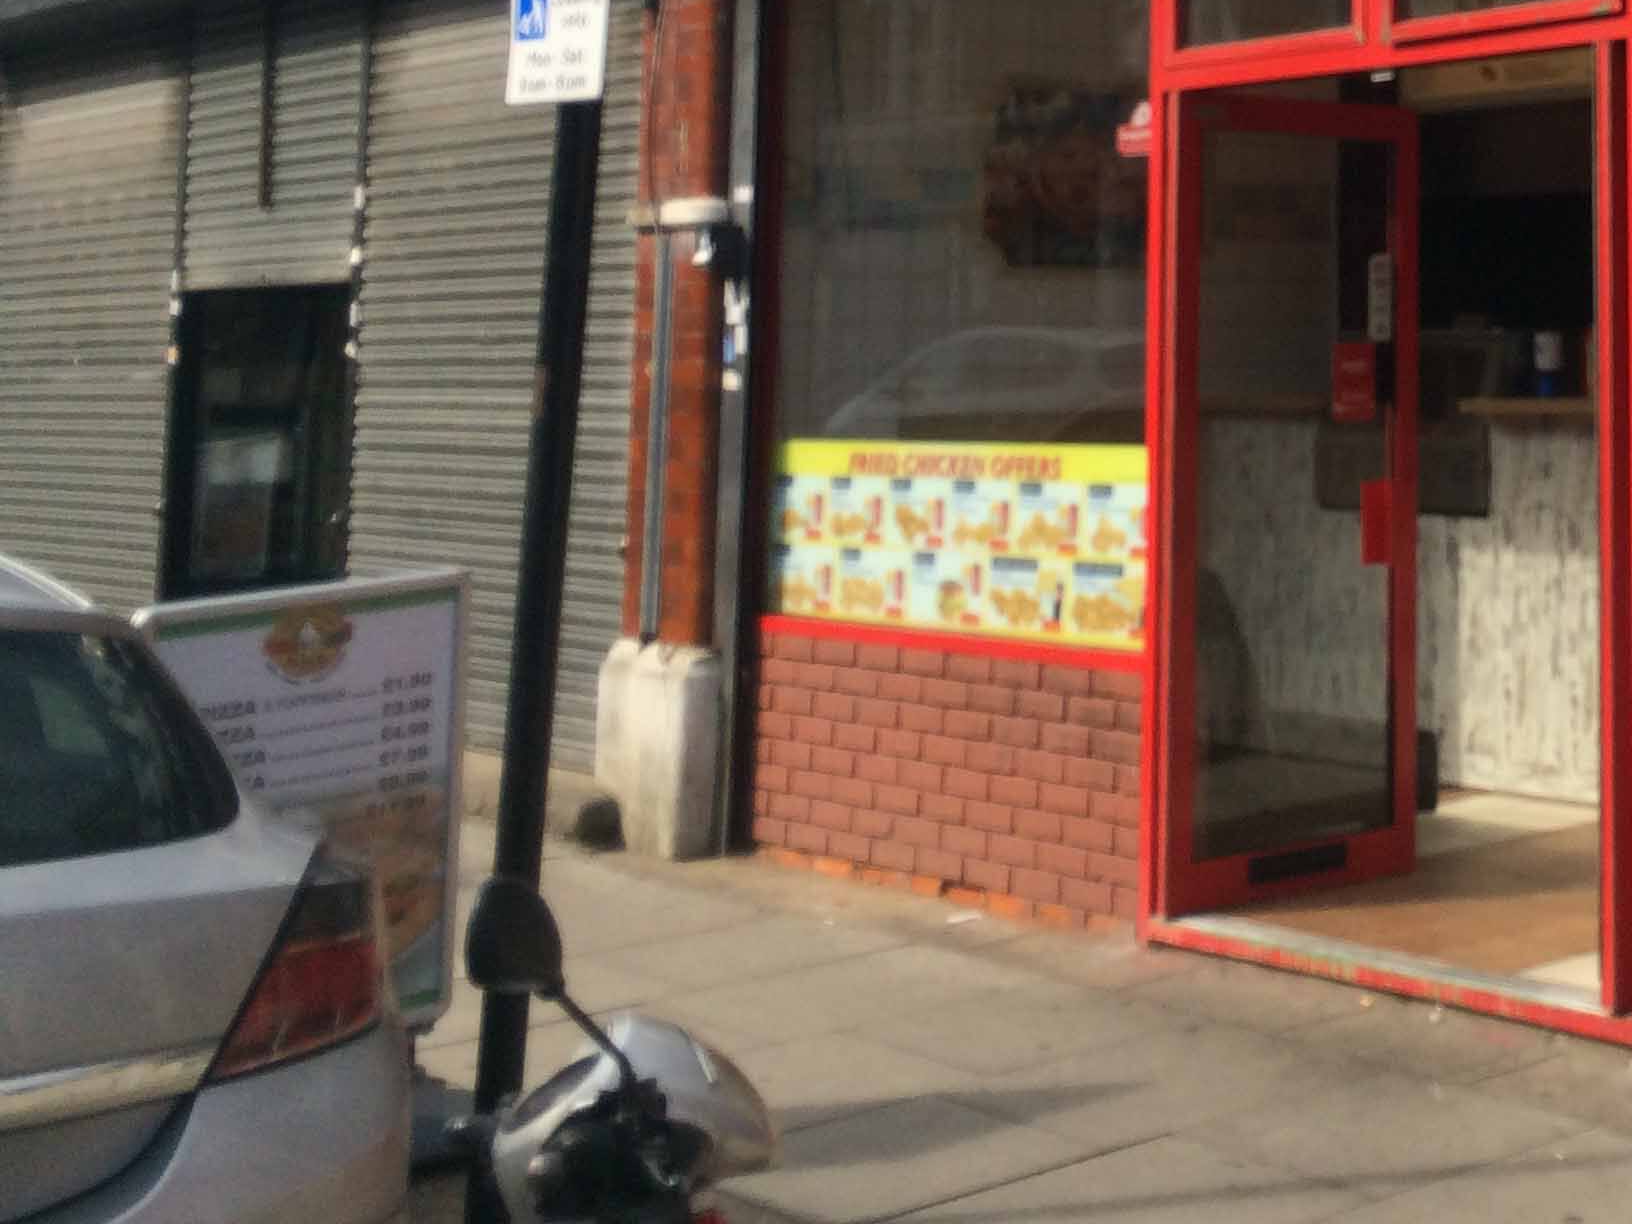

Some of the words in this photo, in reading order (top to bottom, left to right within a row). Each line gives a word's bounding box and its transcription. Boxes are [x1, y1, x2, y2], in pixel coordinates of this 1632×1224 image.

[848, 452, 897, 476] FRIED
[901, 453, 986, 479] CHICKEN
[989, 454, 1062, 480] OFFERS
